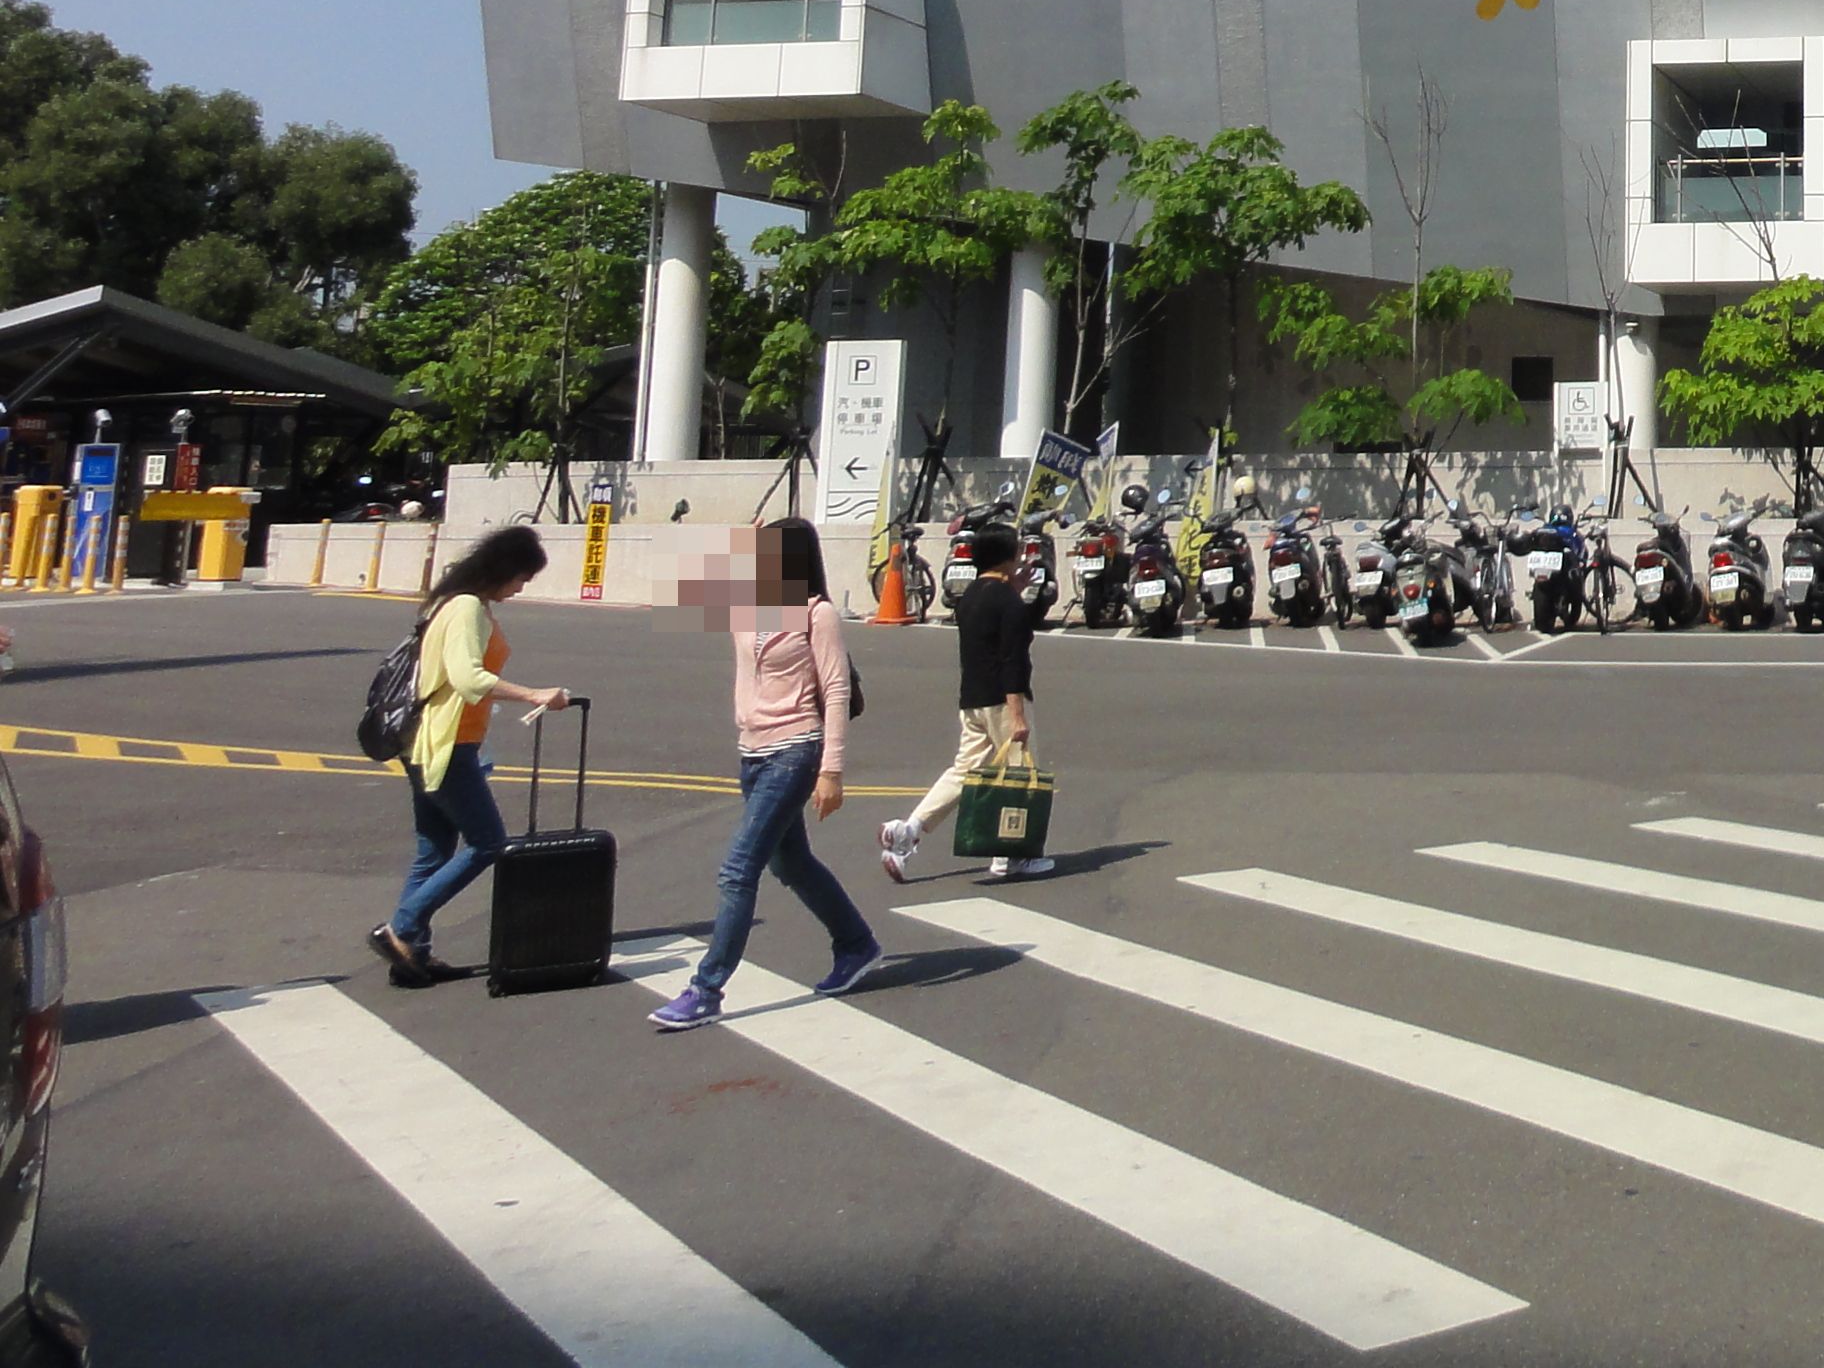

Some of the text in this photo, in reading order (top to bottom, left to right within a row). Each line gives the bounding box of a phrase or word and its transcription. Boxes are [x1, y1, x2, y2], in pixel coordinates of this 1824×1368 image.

[854, 359, 871, 382] P
[584, 506, 607, 584] 機車託運
